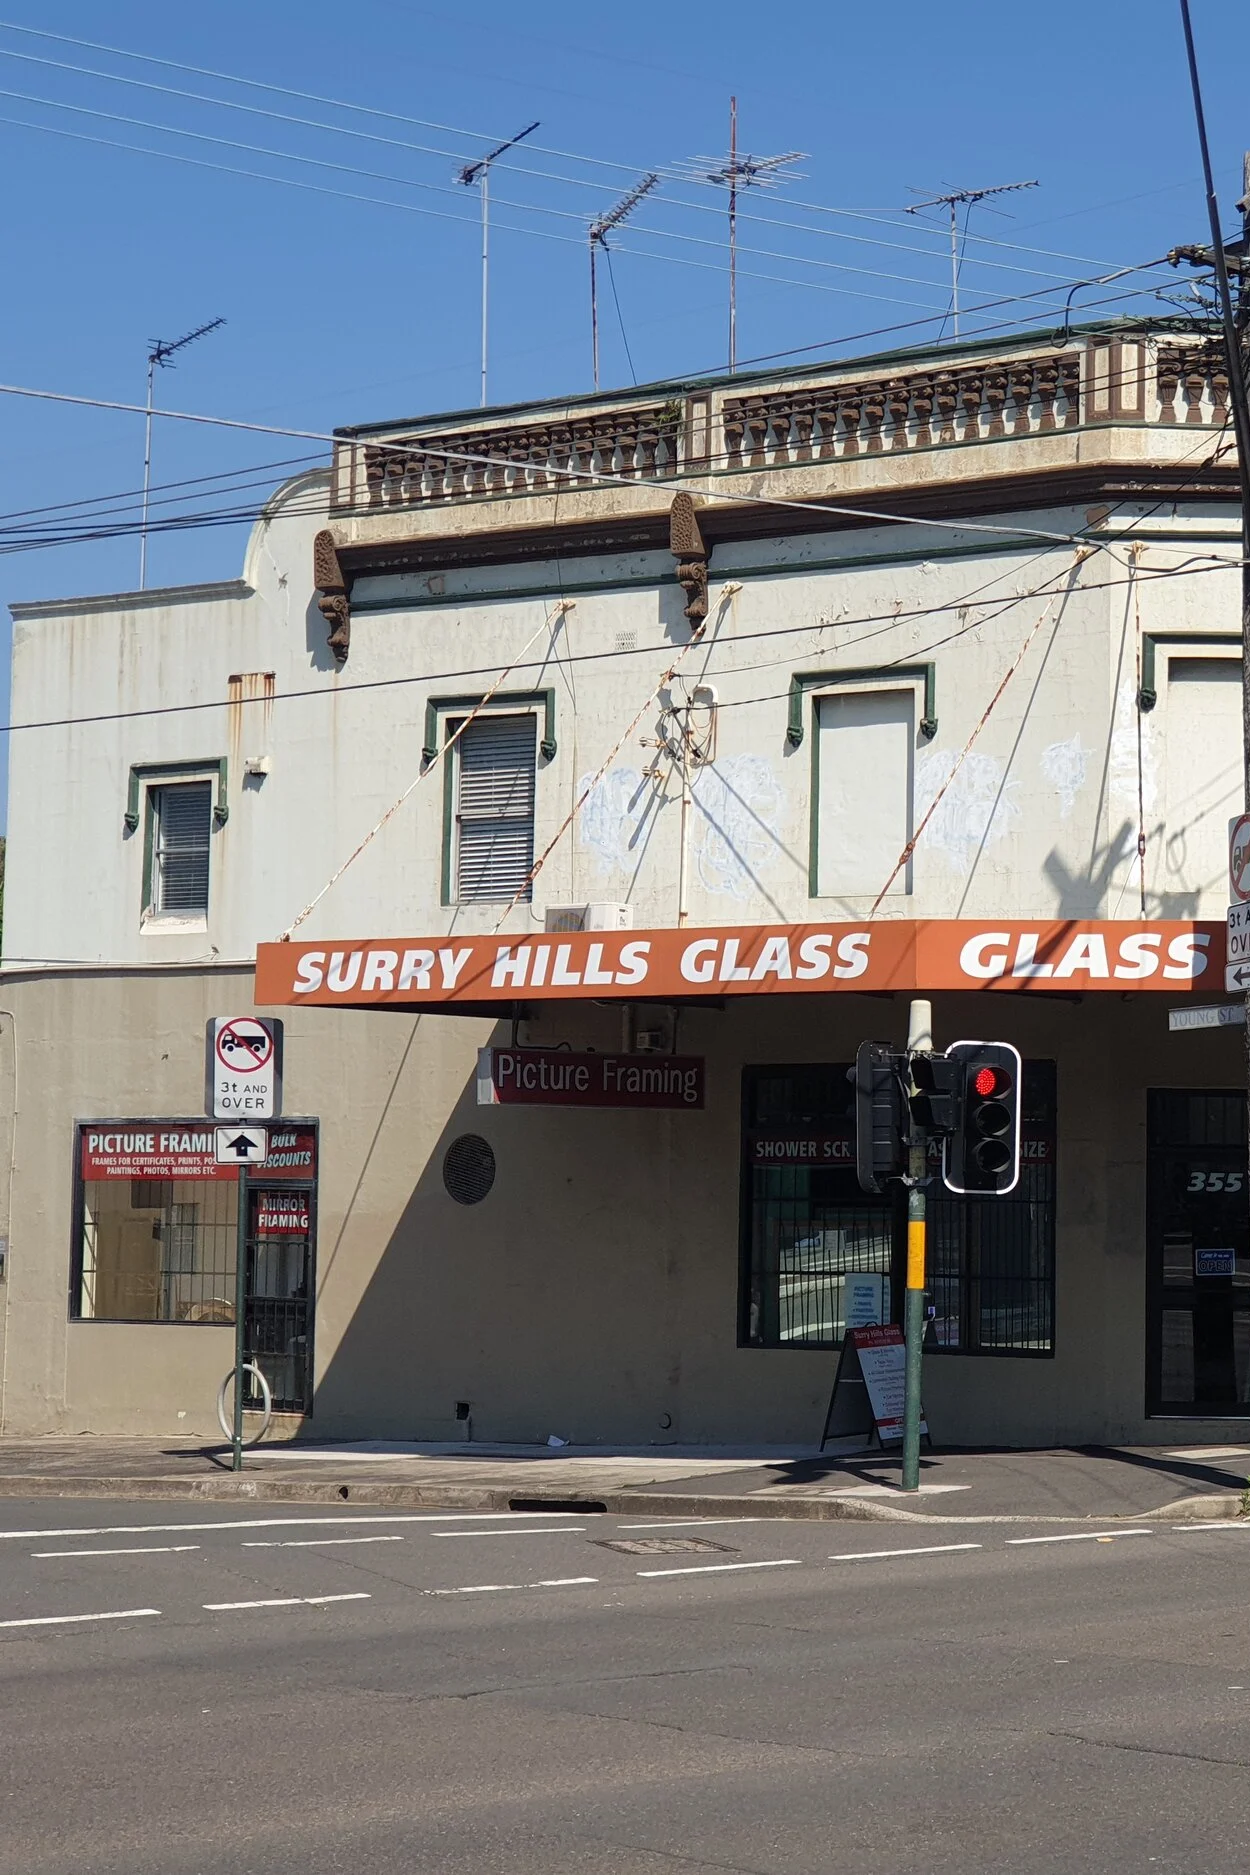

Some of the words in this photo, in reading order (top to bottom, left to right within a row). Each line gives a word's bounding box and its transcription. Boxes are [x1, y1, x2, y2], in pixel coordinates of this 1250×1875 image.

[1229, 911, 1243, 928] 3t
[293, 948, 473, 993] SURRY
[490, 941, 651, 988] HILLS
[680, 933, 871, 983] GLASS
[959, 932, 1211, 980] GLASS
[1171, 1010, 1216, 1028] YOUNG
[1219, 1007, 1235, 1023] ST
[498, 1054, 590, 1091] Picture
[603, 1059, 698, 1103] Framing
[220, 1081, 238, 1093] 3t
[243, 1085, 267, 1094] AND
[221, 1097, 265, 1109] OVER
[88, 1132, 155, 1154] PICTURE
[160, 1132, 214, 1153] FRAMI
[271, 1133, 297, 1148] BULK
[755, 1141, 817, 1158] SHOWER
[91, 1157, 117, 1166] FRAMES
[118, 1157, 131, 1165] FOR
[132, 1156, 176, 1167] CERTIFICATES,
[178, 1156, 202, 1167] PRINTS,
[257, 1151, 312, 1168] SCOUNTS
[107, 1166, 142, 1176] PAINTINGS,
[143, 1166, 170, 1176] PHOTOS,
[172, 1166, 201, 1175] MIRRORS
[202, 1166, 217, 1175] ETC.
[1187, 1171, 1244, 1192] 355
[262, 1198, 306, 1212] MIRROR
[258, 1213, 309, 1228] FRAMING
[1199, 1259, 1233, 1272] OPEN
